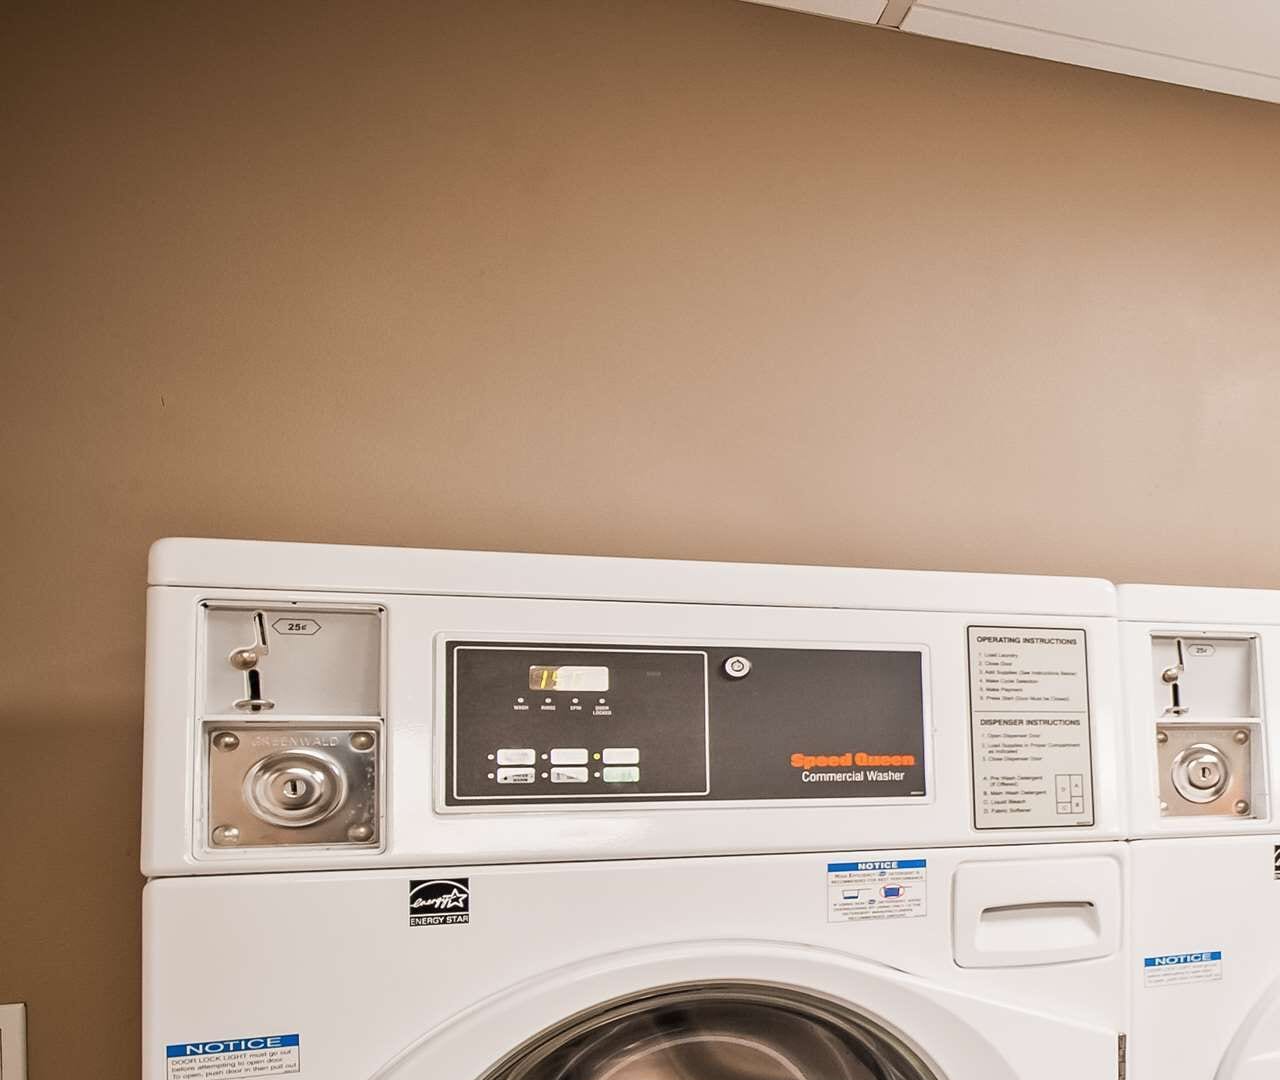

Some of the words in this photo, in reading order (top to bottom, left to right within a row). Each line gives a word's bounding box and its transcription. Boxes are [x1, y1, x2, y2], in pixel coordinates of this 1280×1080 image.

[976, 636, 1020, 644] OPERATING
[790, 752, 853, 770] Speed
[854, 752, 915, 766] Queen
[802, 770, 864, 782] Commercial
[866, 770, 905, 781] Washer
[858, 861, 898, 870] NOTICE
[410, 916, 444, 925] ENERGY
[446, 915, 469, 923] STAR
[1154, 953, 1211, 965] NOTICE
[186, 1037, 282, 1054] NOTICE
[172, 1058, 197, 1066] DOOR
